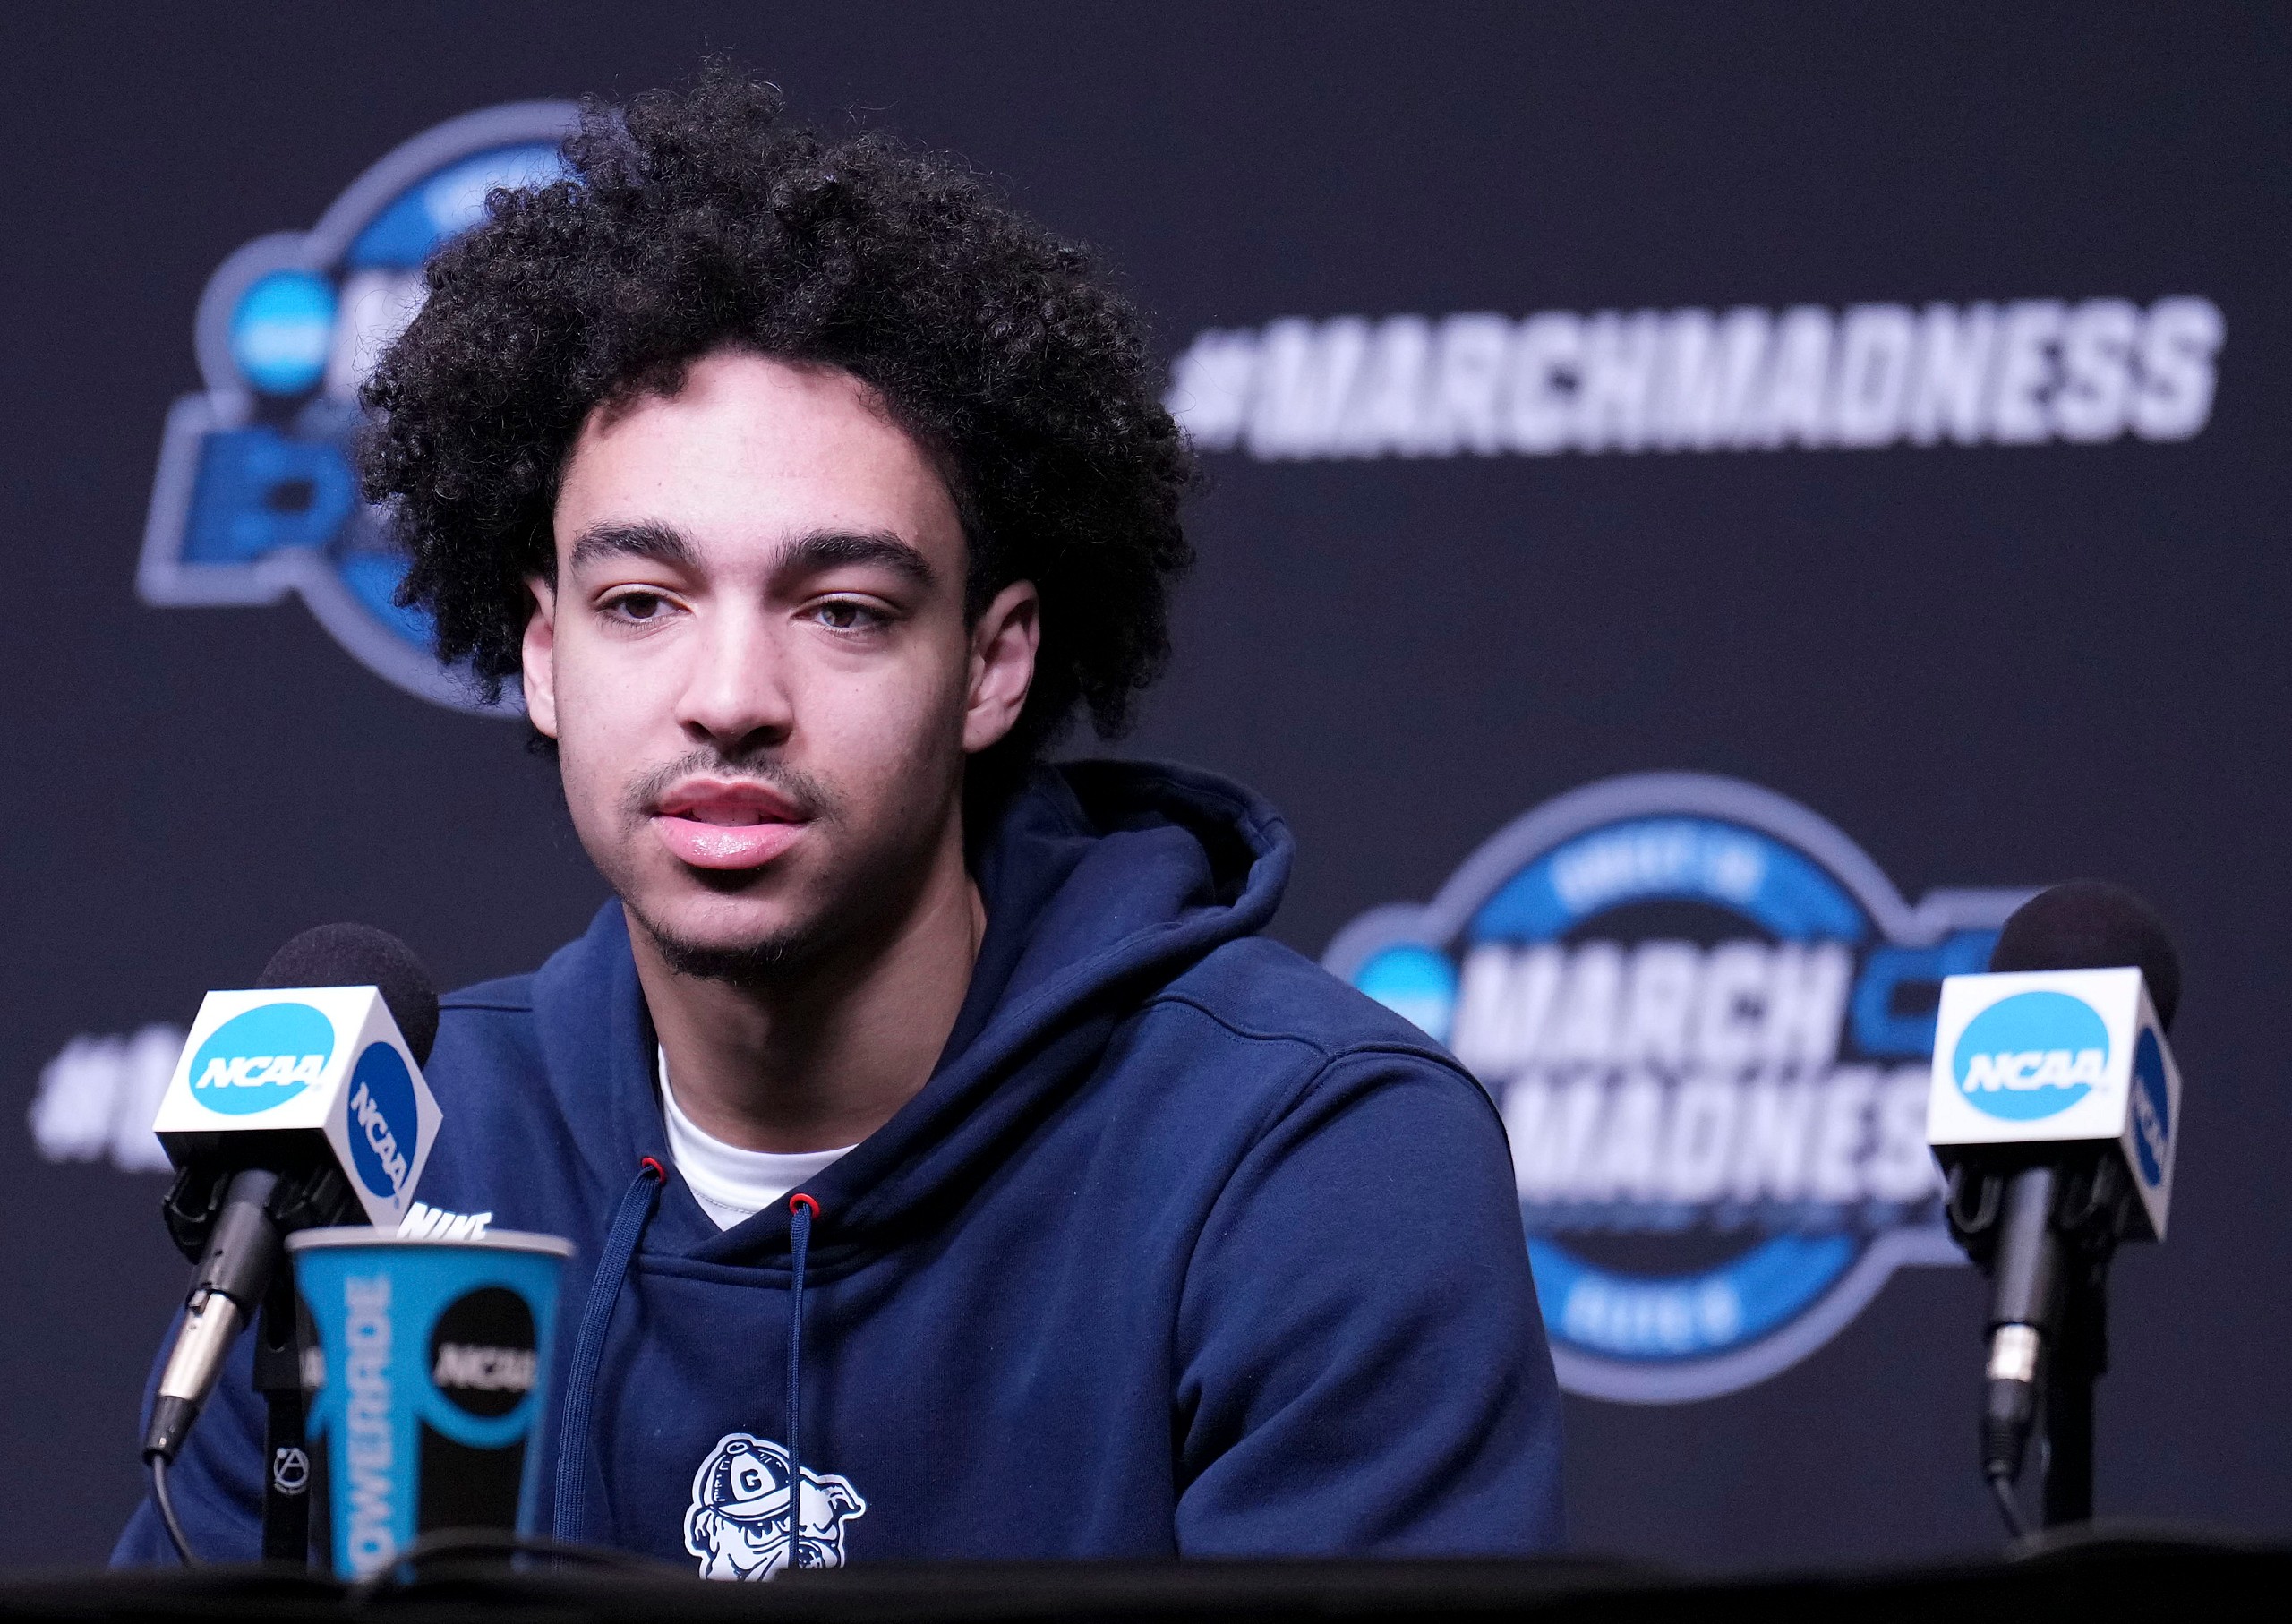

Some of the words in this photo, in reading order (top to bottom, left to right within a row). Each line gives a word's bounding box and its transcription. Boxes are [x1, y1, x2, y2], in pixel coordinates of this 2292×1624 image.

[1452, 936, 1853, 1071] MARCH
[196, 1056, 324, 1089] NCAA
[1963, 1048, 2108, 1092] NCAA
[350, 1081, 407, 1195] NCAA
[1509, 1071, 1943, 1204] MADNES
[396, 1201, 492, 1241] NIKE
[346, 1275, 396, 1581] OWERADE
[740, 1468, 763, 1493] G
